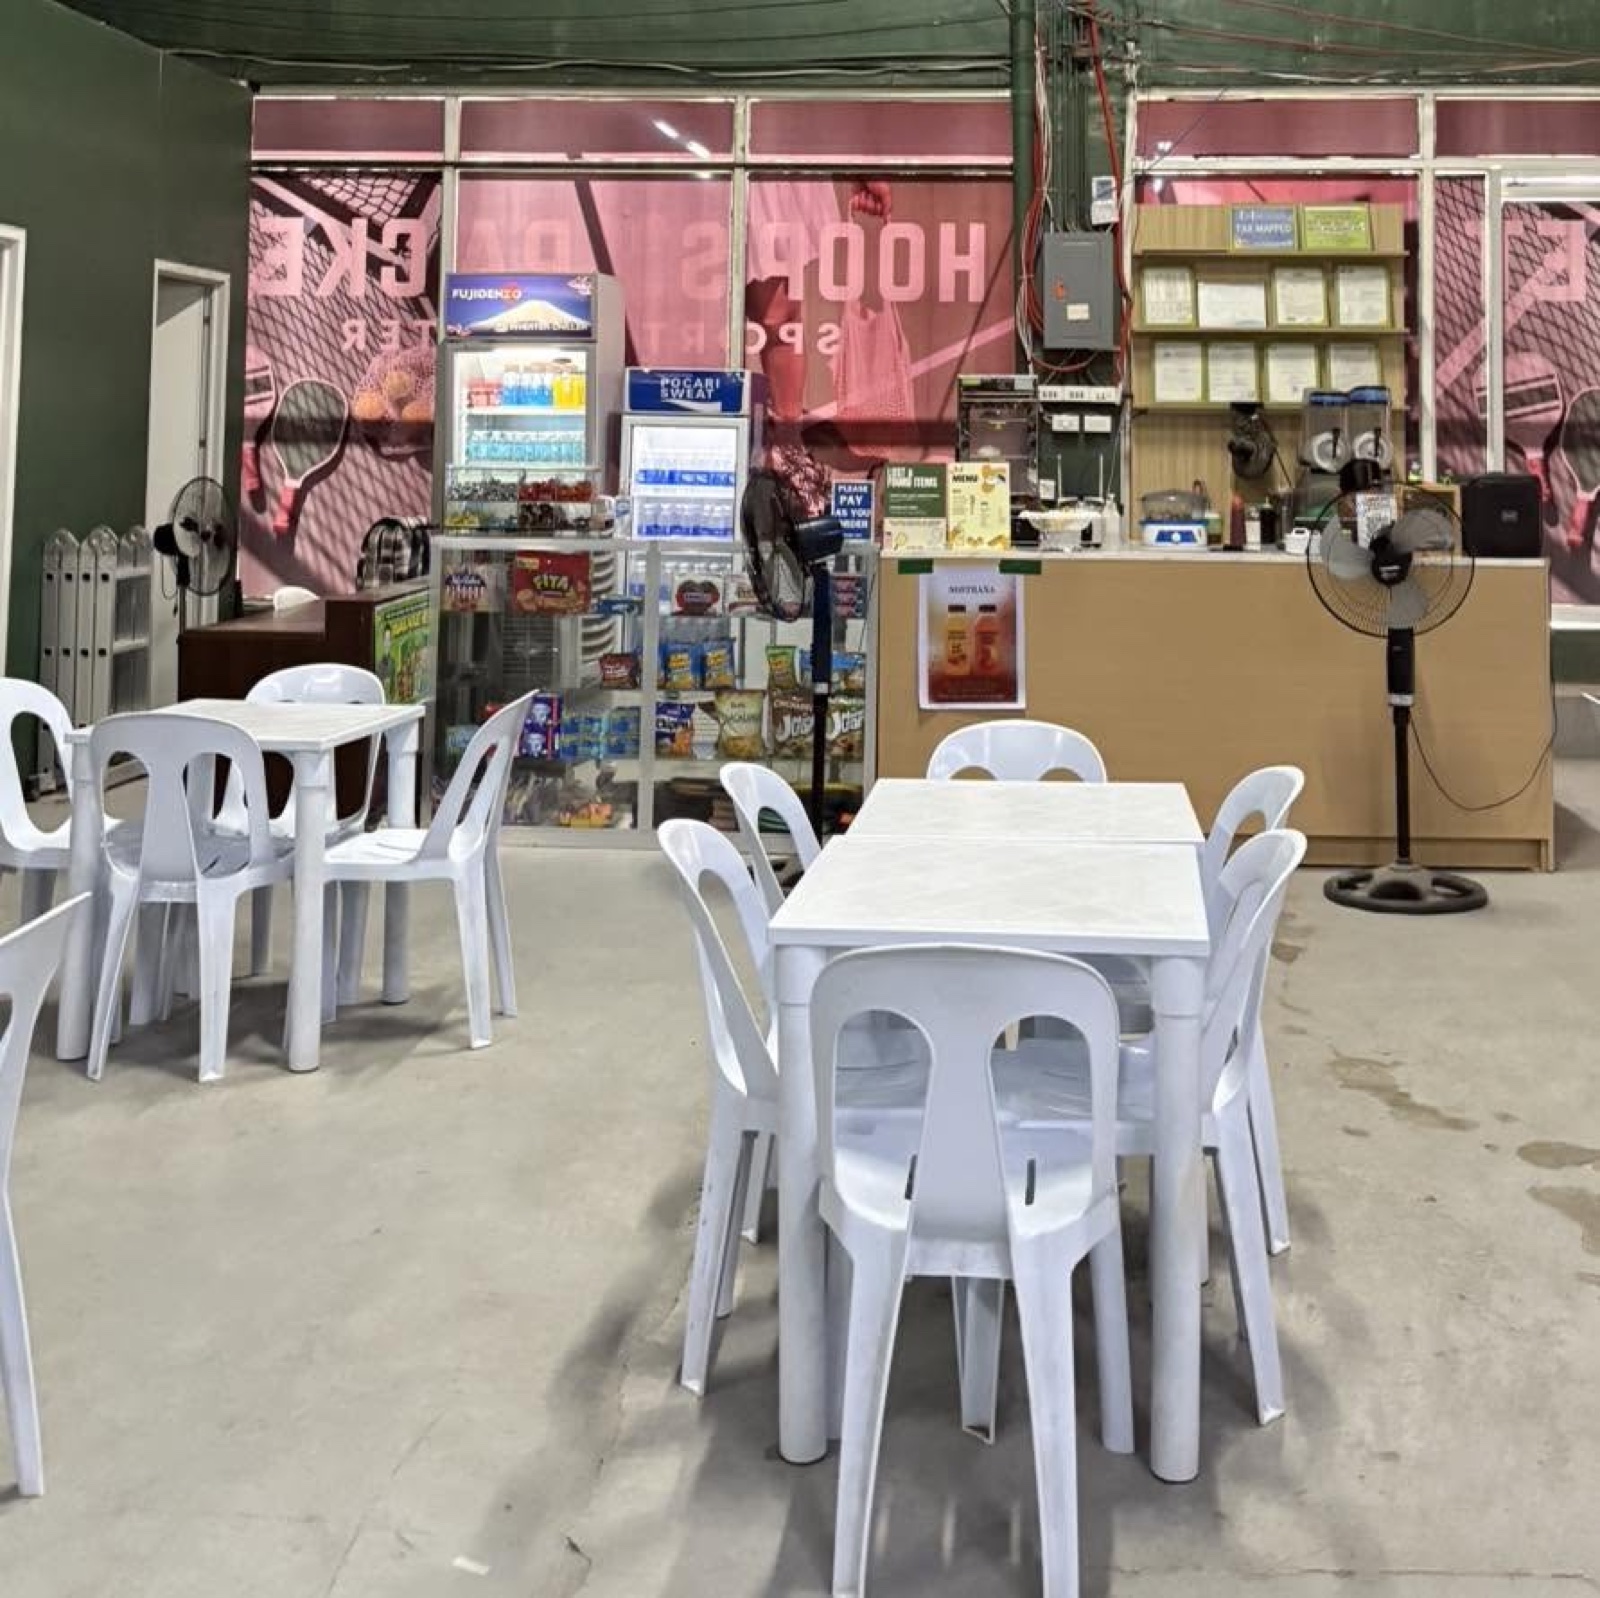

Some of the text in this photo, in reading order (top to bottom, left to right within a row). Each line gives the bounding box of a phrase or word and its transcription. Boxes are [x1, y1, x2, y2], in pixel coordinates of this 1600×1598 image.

[452, 288, 522, 301] FUJIDENZO
[659, 377, 731, 389] POCARI
[659, 389, 724, 400] SWEAT
[952, 474, 978, 483] MENU
[838, 485, 868, 493] PLEASE
[840, 495, 863, 506] PAY
[836, 508, 871, 517] AS YOU
